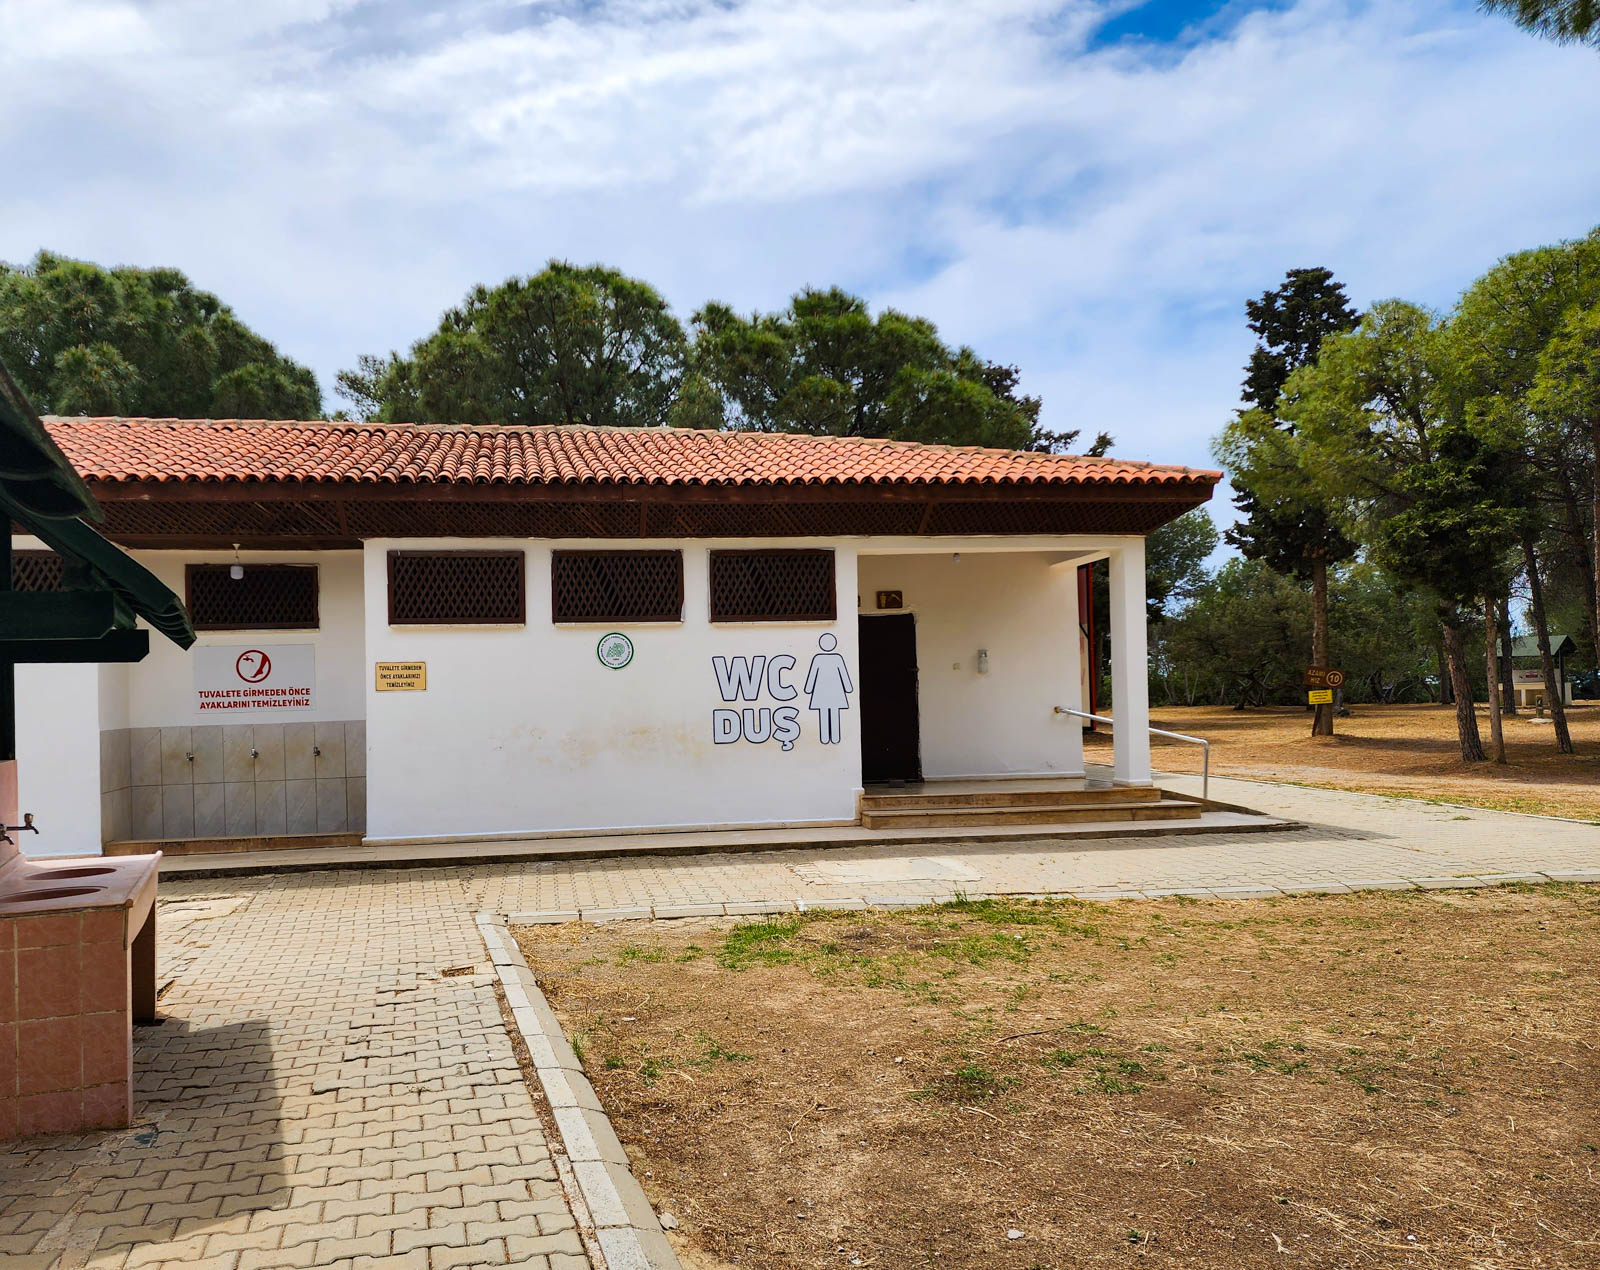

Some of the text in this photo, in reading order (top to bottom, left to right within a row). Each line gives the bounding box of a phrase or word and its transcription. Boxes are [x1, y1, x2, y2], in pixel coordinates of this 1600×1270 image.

[712, 654, 798, 702] WC
[1329, 674, 1340, 683] 10
[198, 686, 311, 699] TUVALETE GİRMEDEN ÖNCE
[199, 697, 310, 710] AYAKLARINI TEMİZLEYİNİZ
[712, 706, 801, 752] DUŞ
